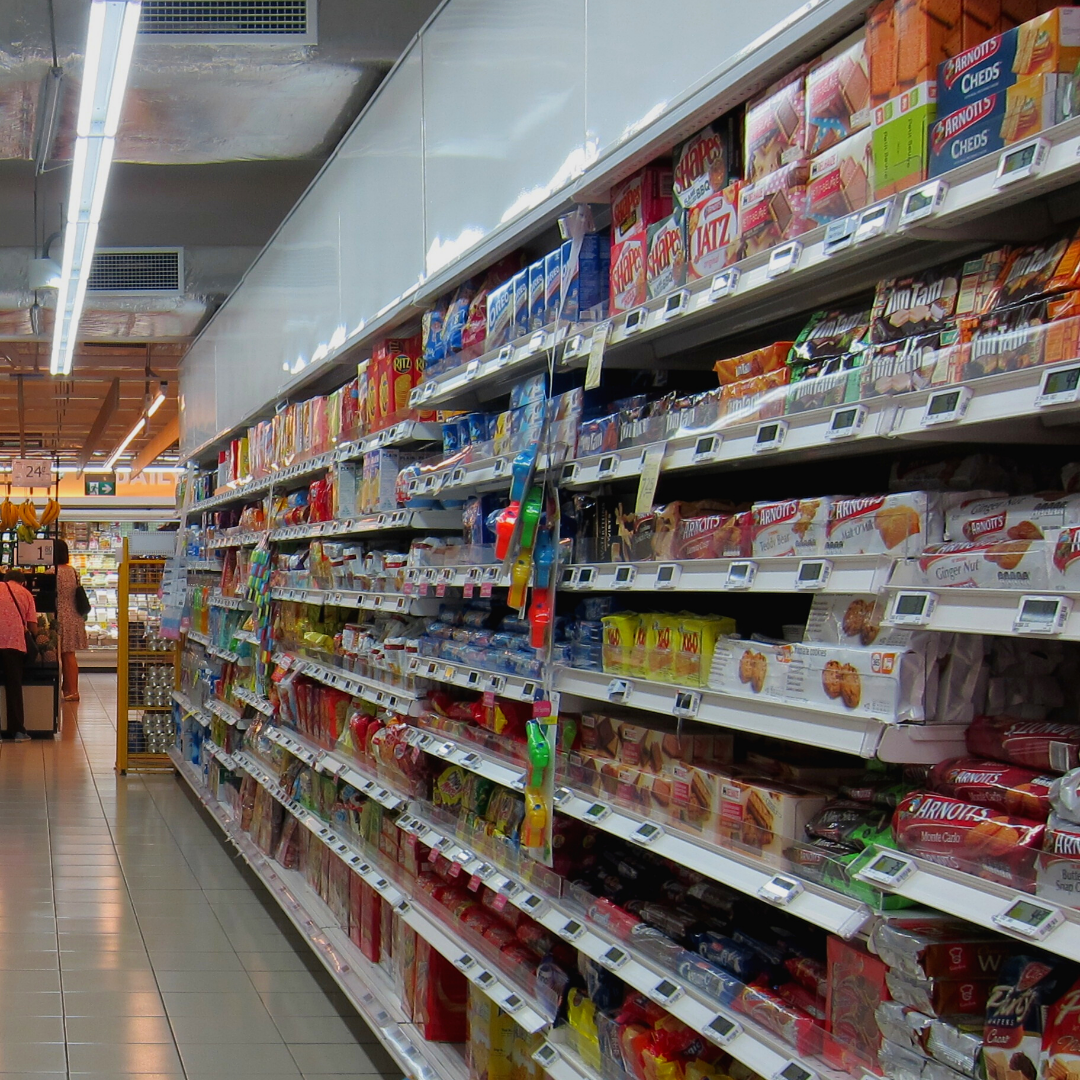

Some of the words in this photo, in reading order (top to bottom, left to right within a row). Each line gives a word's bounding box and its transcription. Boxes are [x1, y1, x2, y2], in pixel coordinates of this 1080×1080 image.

[960, 62, 1001, 94] CHEDS
[951, 129, 989, 159] CHEDS
[695, 179, 711, 198] BBQ
[694, 212, 731, 264] JATZ
[488, 290, 509, 328] OREO
[394, 356, 412, 370] RITZ
[970, 498, 1003, 515] Ginger
[759, 536, 776, 552] Teddy
[776, 532, 790, 546] Bear
[935, 562, 962, 581] Ginger
[963, 559, 980, 573] Nut
[921, 830, 941, 844] Monte
[941, 832, 962, 844] Carlo
